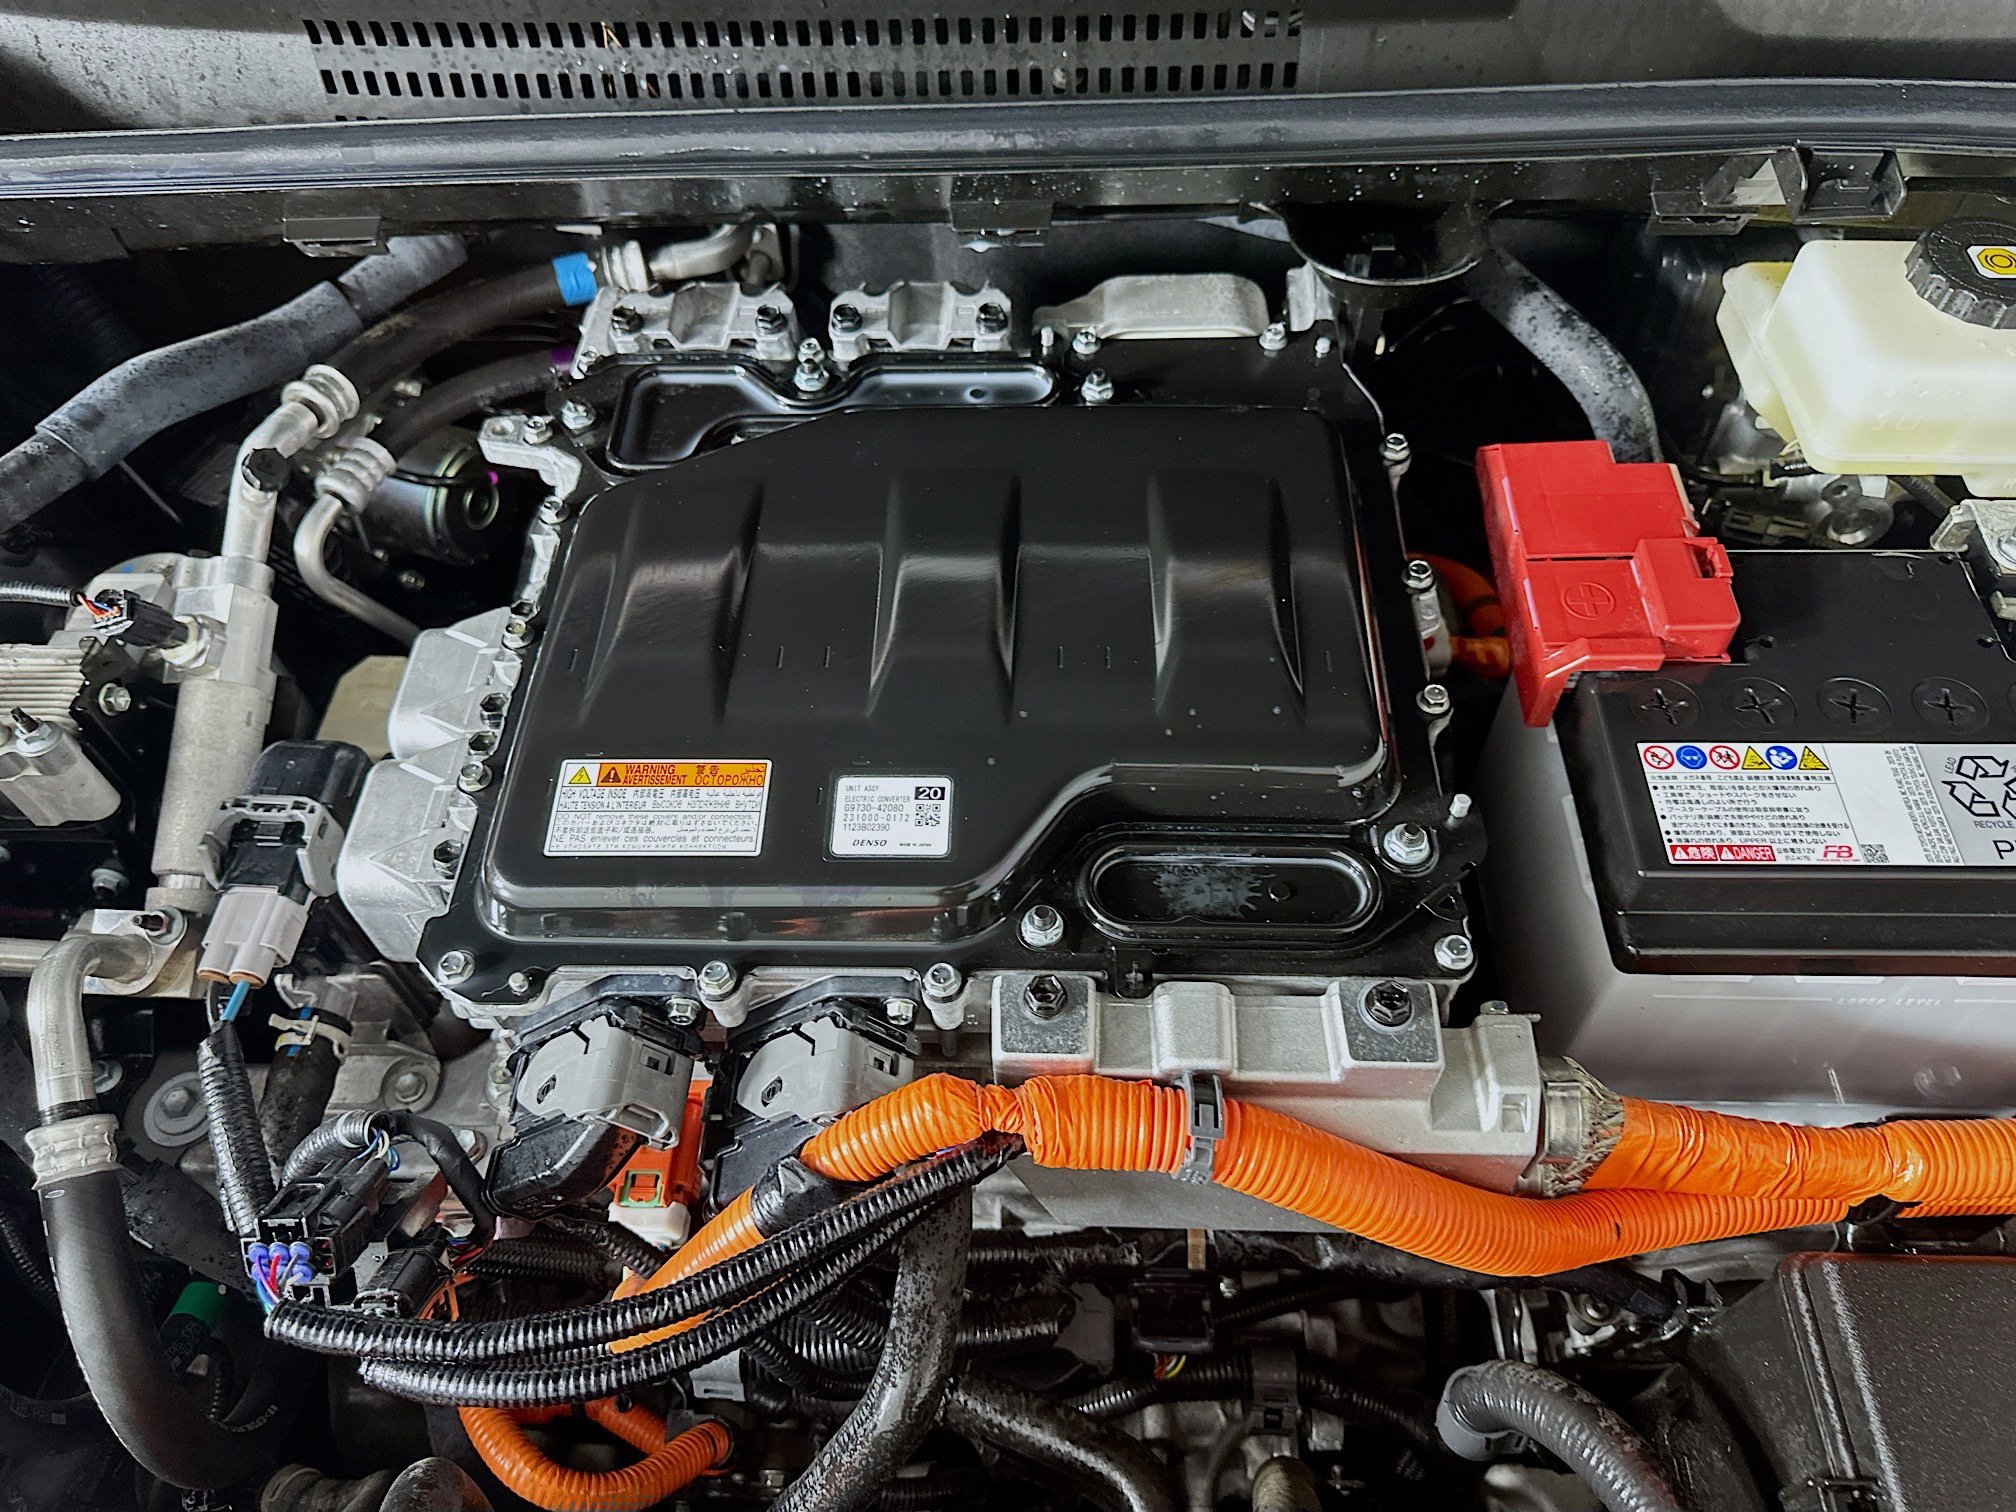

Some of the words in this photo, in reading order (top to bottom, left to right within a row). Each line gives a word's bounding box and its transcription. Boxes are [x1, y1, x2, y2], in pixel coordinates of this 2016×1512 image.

[626, 765, 675, 774] WARNING
[1944, 757, 1956, 774] LEAD
[623, 775, 687, 785] AVERTISSEMENT
[695, 775, 763, 785] ОСТОРОЖНО
[562, 789, 576, 798] HIGH
[579, 789, 605, 798] VOLTAGE
[607, 789, 627, 798] INSIDE
[918, 787, 942, 800] 20
[844, 804, 904, 812] G9730-42080
[844, 814, 910, 822] 231000-0172
[1974, 820, 2015, 828] RECYCLE
[552, 834, 564, 842] NE
[570, 834, 586, 842] PAS
[590, 834, 620, 842] enlever
[624, 834, 638, 842] ces
[644, 834, 686, 842] couvercles
[692, 834, 700, 842] et
[1687, 846, 1716, 860] 危険
[1732, 846, 1774, 860] DANGER
[1993, 840, 2016, 860] P
